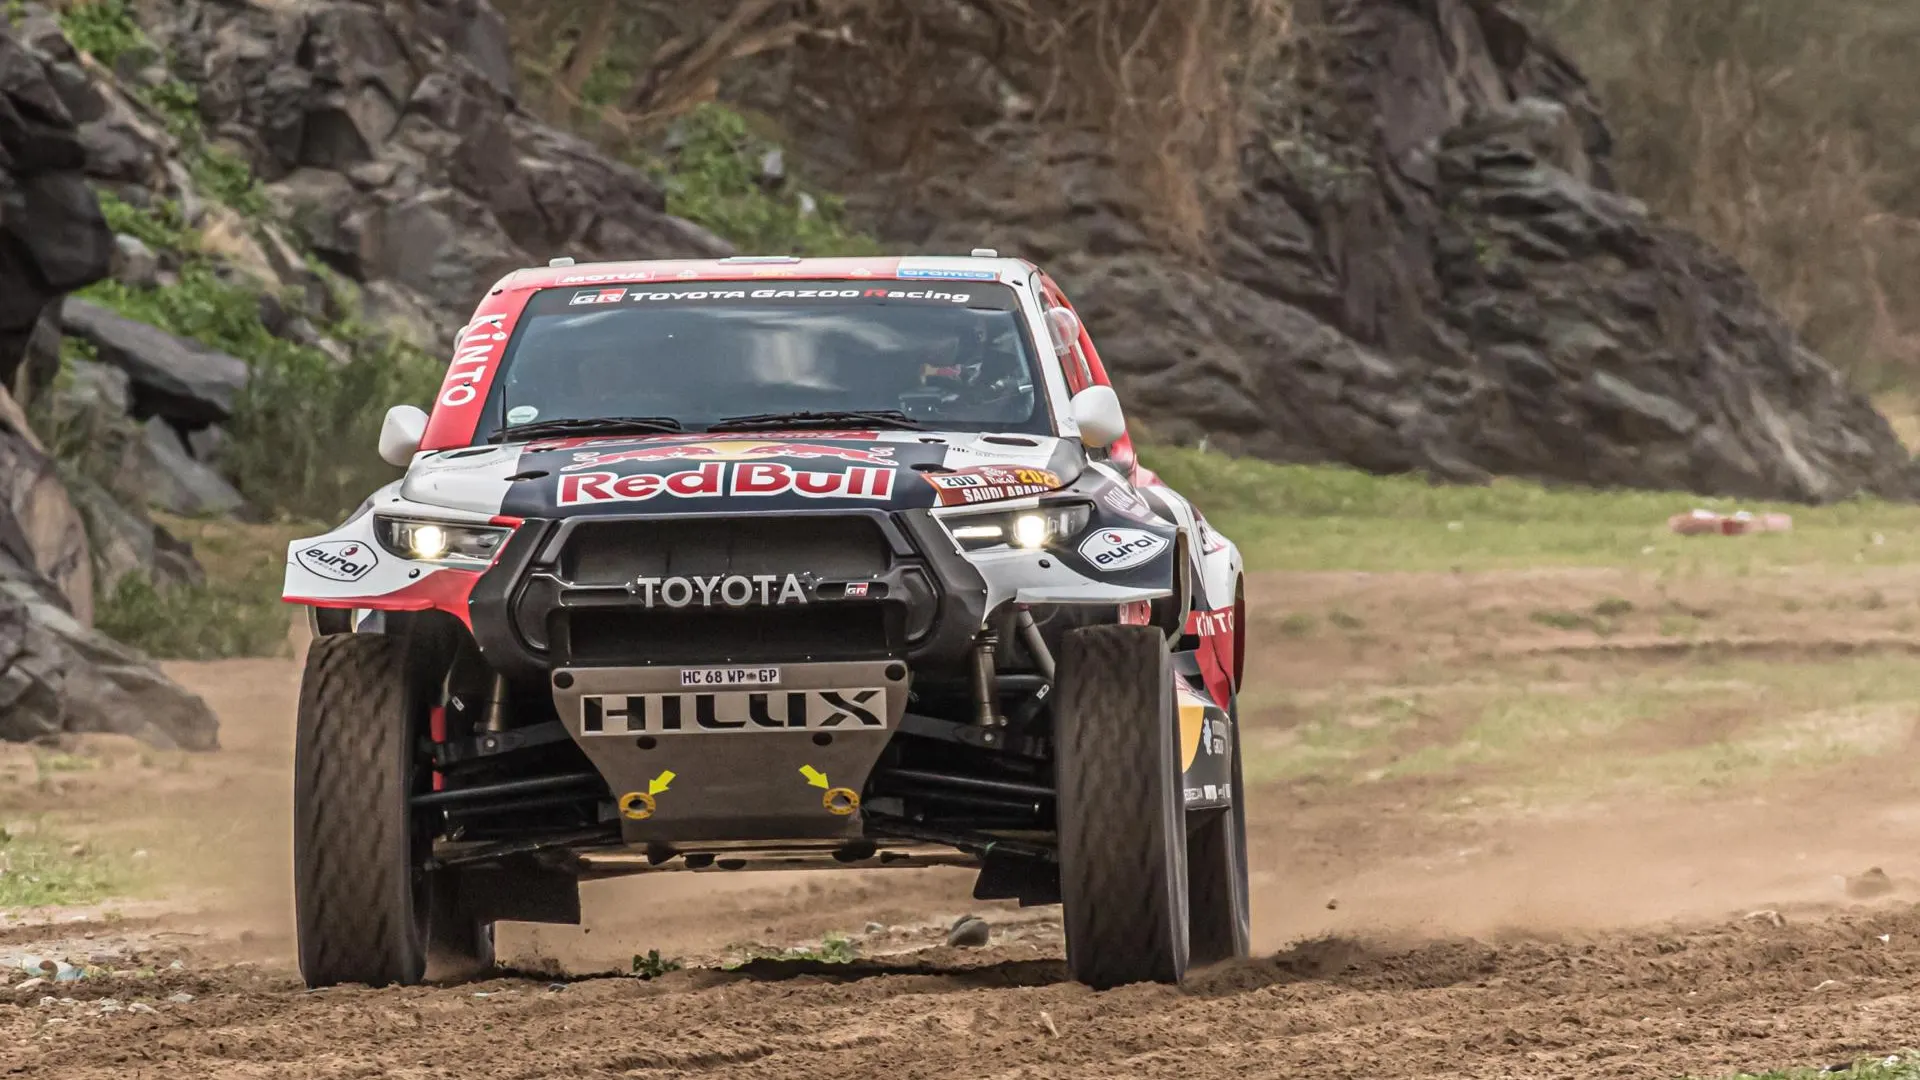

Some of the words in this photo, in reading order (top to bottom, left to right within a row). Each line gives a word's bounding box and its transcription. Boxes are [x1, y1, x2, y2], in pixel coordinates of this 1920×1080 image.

[904, 269, 990, 279] aramco
[571, 291, 624, 305] GR
[630, 290, 745, 302] TOYOTA
[751, 289, 859, 299] GAZOO
[863, 288, 970, 303] Racing
[561, 463, 720, 504] Red
[735, 463, 892, 498] Bull
[938, 476, 977, 487] 200
[962, 487, 1004, 503] SAUDI
[1096, 534, 1157, 564] eurol
[306, 548, 368, 577] eurol
[637, 573, 808, 608] TOYOTA
[846, 586, 867, 596] GR
[682, 671, 701, 684] HC
[705, 670, 723, 684] 68
[727, 670, 745, 683] WP
[758, 669, 777, 682] GP
[584, 690, 883, 732] HILUX
